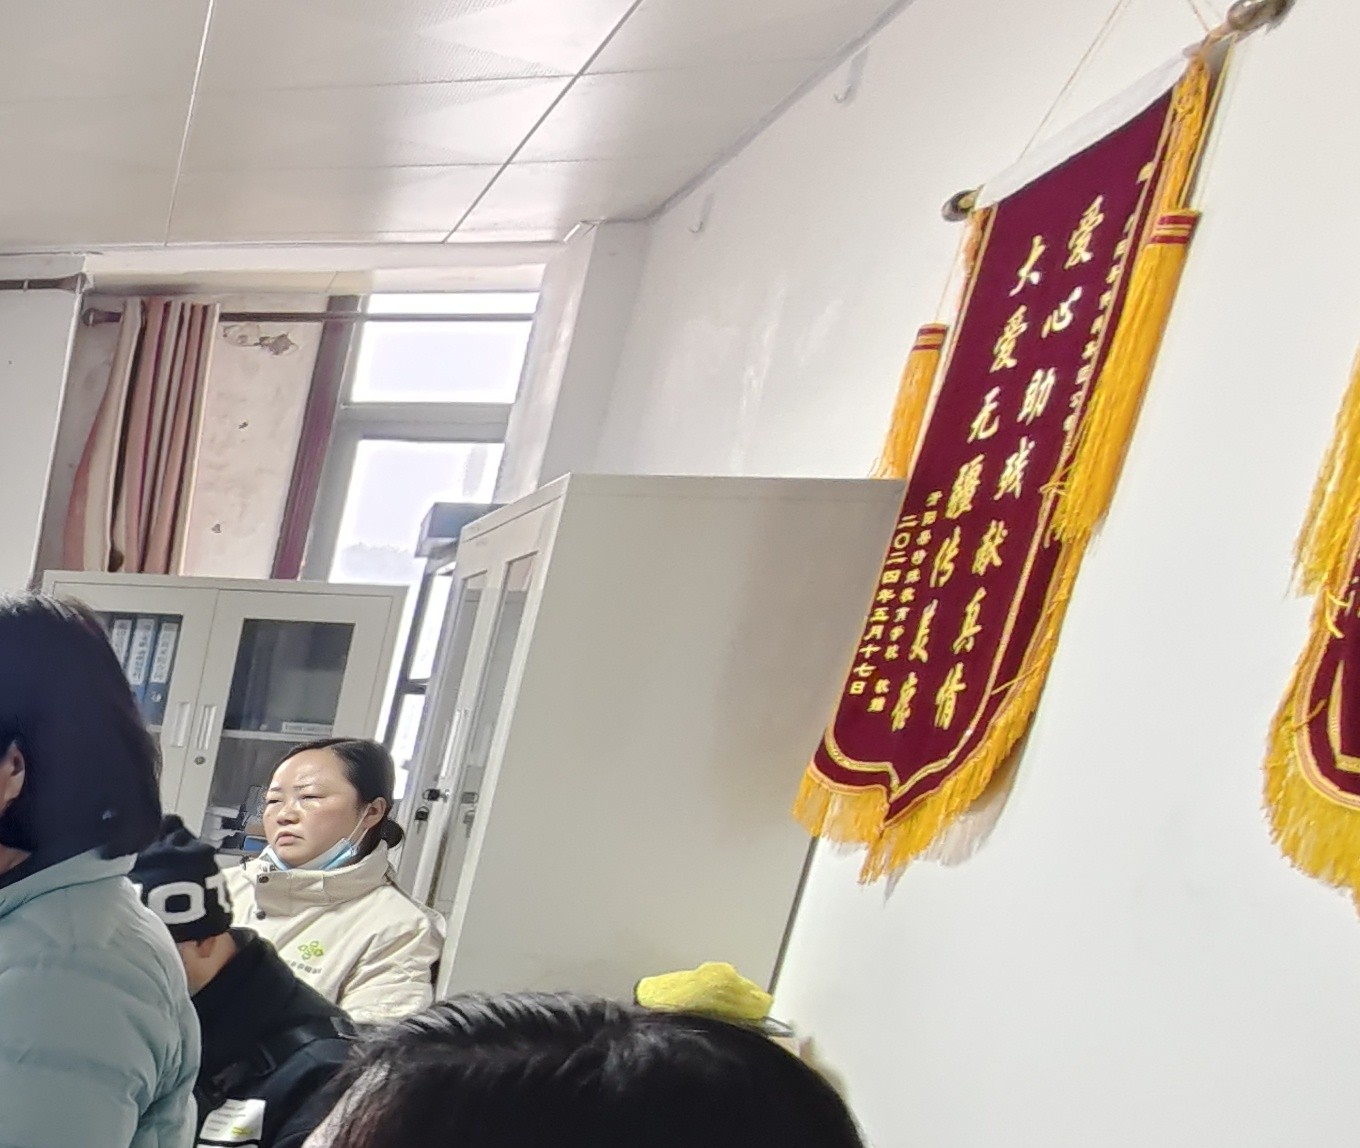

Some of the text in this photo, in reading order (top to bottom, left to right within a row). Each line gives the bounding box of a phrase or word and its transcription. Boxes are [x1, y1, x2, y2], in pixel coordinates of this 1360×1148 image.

[934, 195, 1105, 731] 爱心助残献真情
